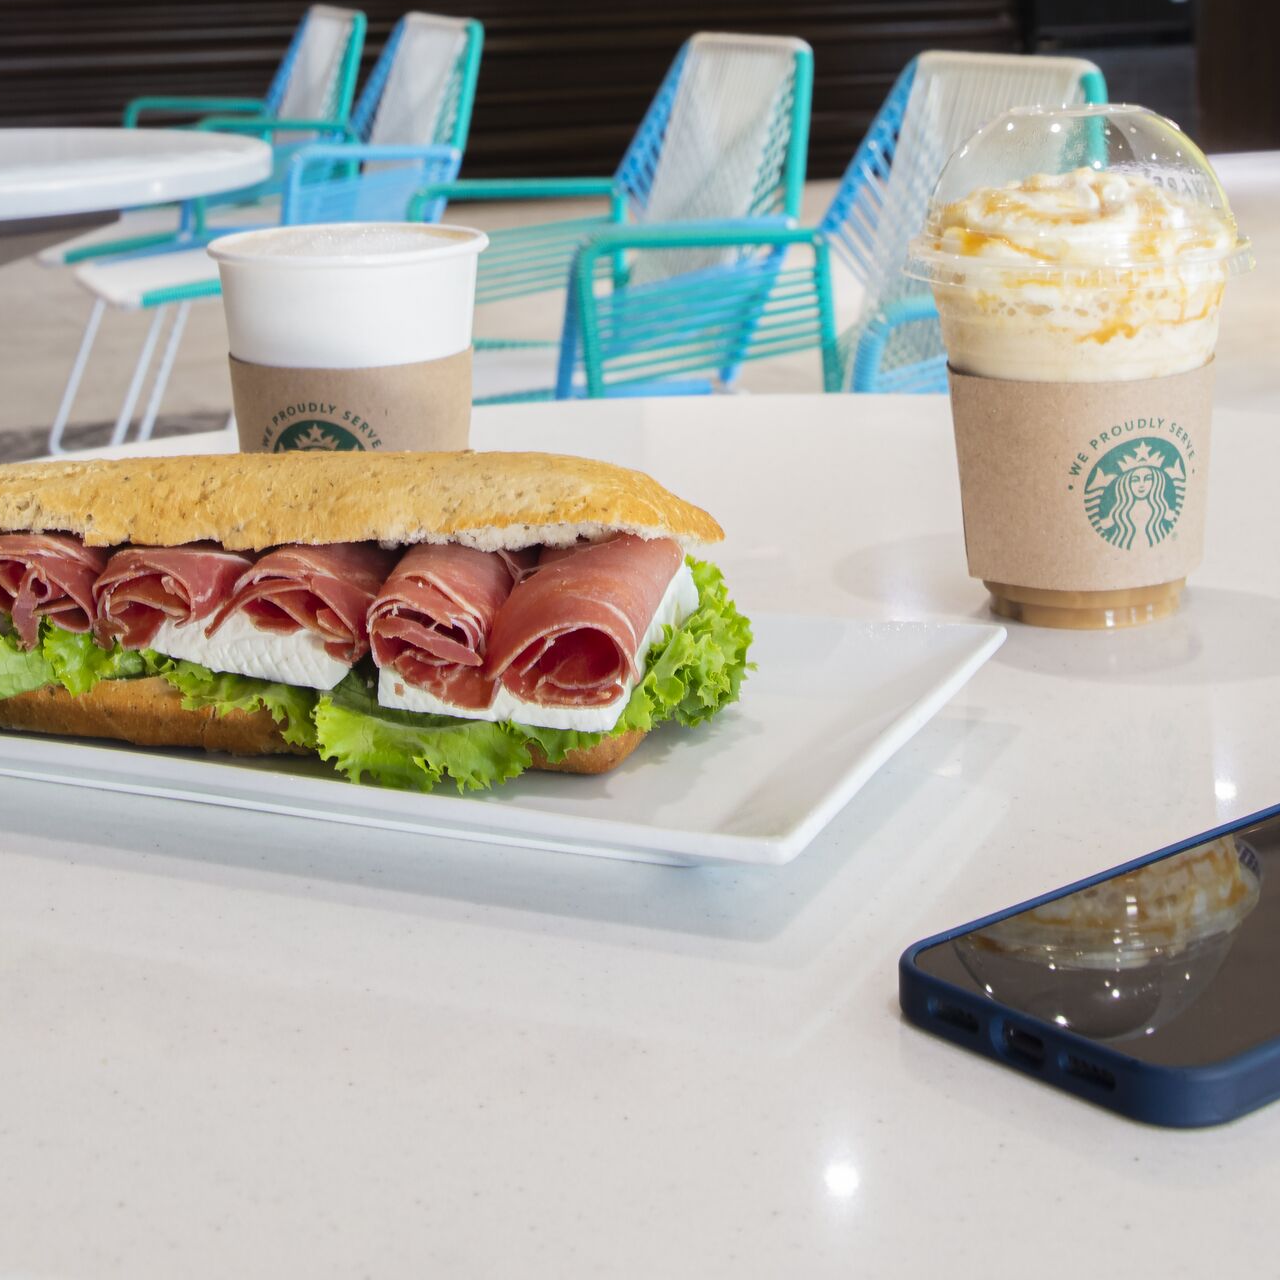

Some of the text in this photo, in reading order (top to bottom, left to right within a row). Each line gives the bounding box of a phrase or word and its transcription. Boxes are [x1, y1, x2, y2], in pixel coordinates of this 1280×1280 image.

[262, 402, 383, 449] WE PROUDLY SERVE
[1068, 417, 1196, 476] WE PROUDLY SERVE
